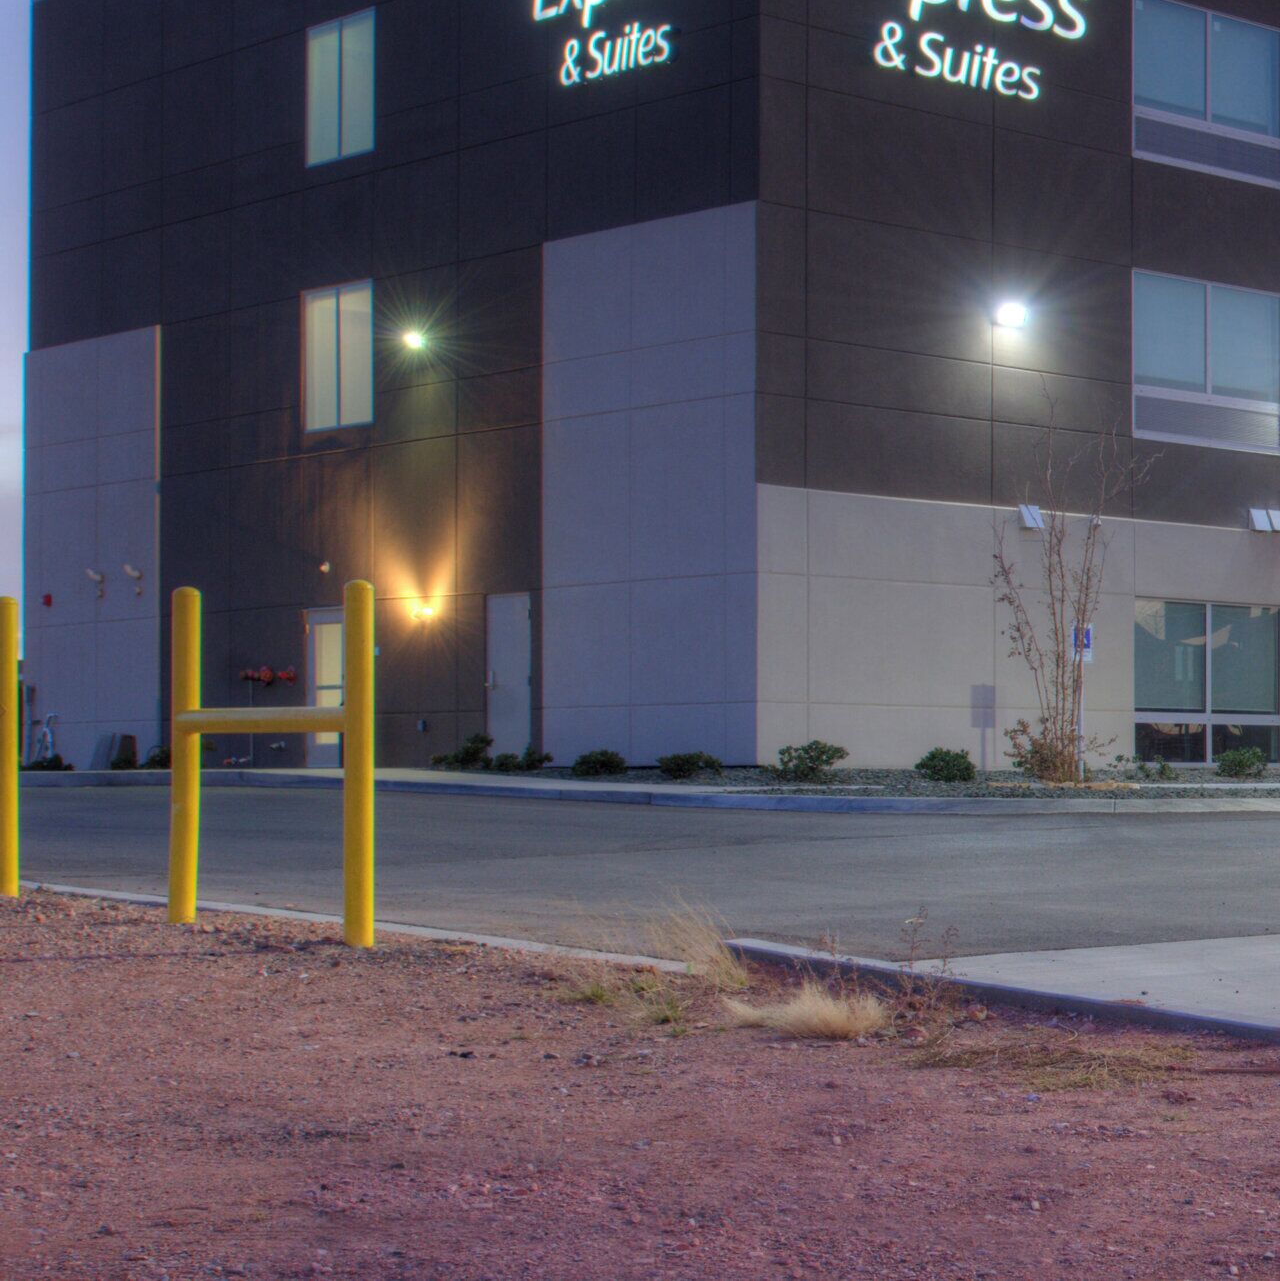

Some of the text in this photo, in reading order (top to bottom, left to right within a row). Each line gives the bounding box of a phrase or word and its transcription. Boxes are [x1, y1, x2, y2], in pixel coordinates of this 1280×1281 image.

[560, 21, 672, 87] & Suites
[873, 20, 1042, 101] & Suites
